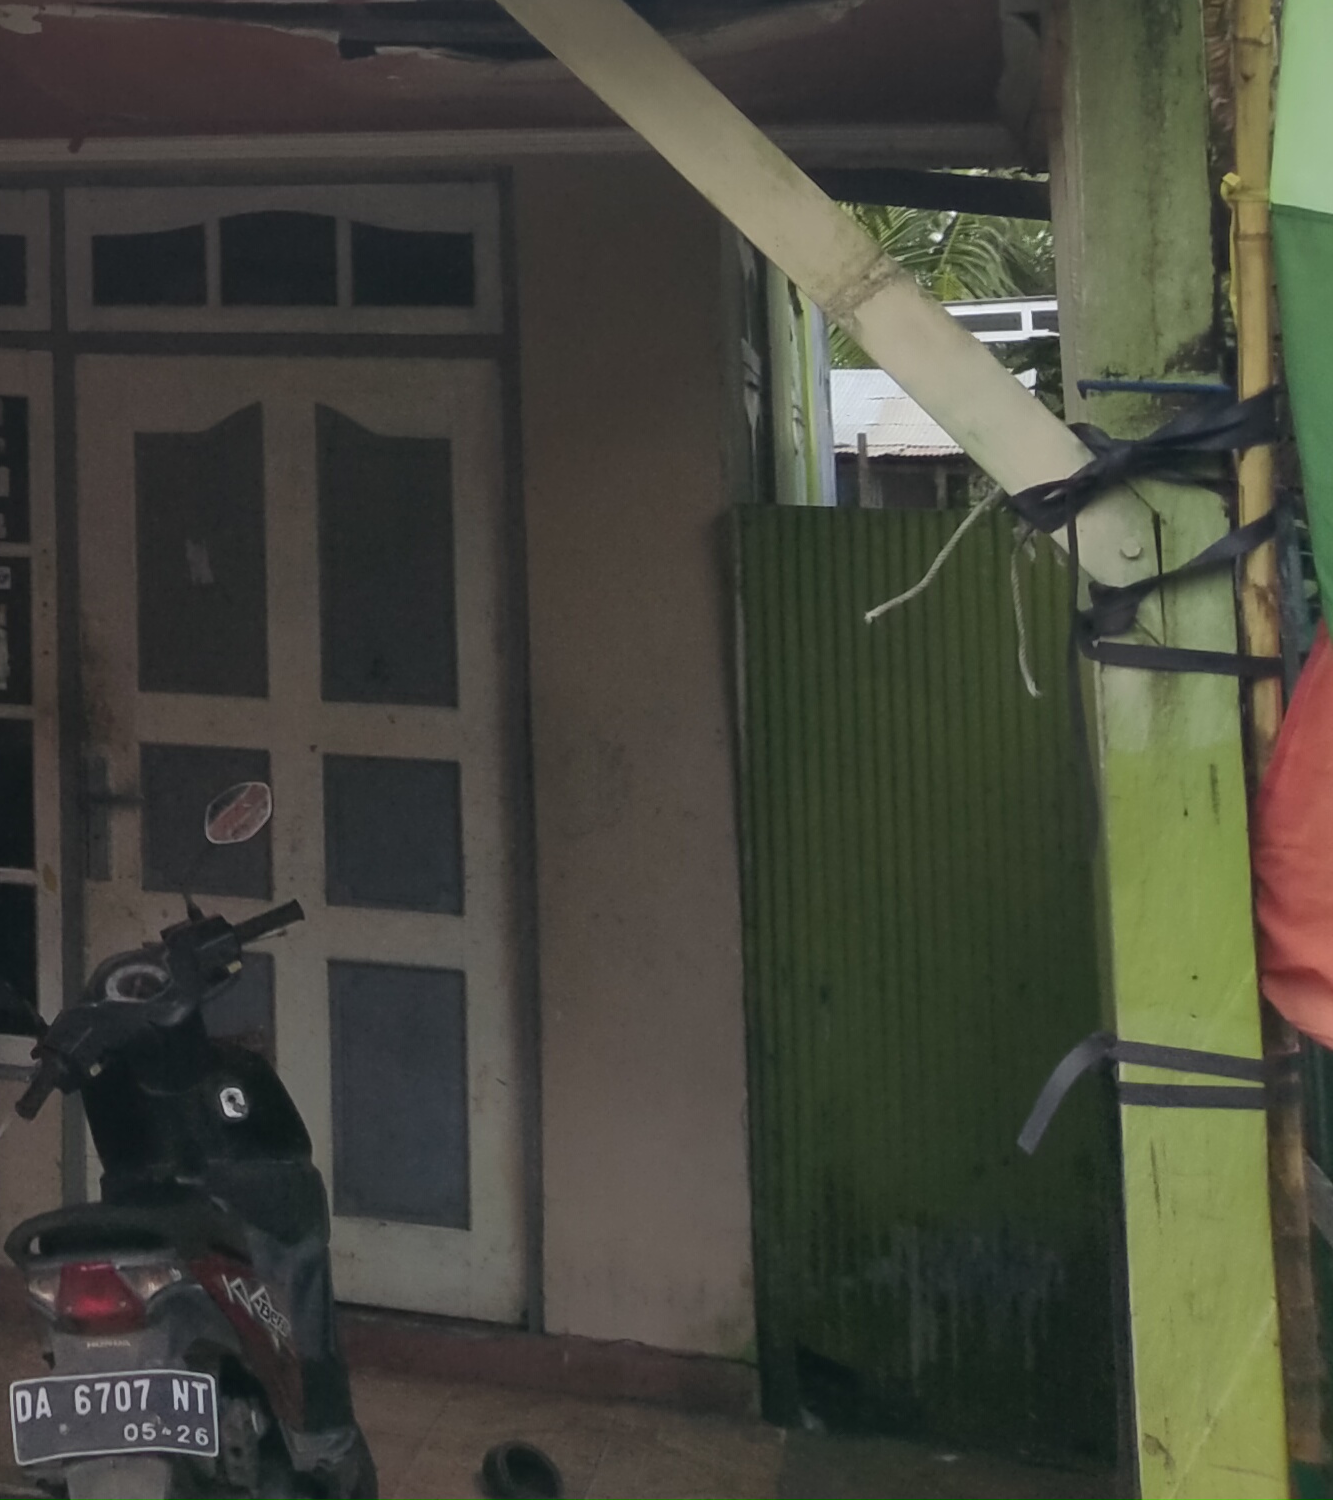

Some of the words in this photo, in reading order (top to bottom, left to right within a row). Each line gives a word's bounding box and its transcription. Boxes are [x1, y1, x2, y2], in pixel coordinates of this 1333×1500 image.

[15, 1386, 52, 1423] DA
[73, 1378, 151, 1416] 6707
[172, 1378, 209, 1414] NT
